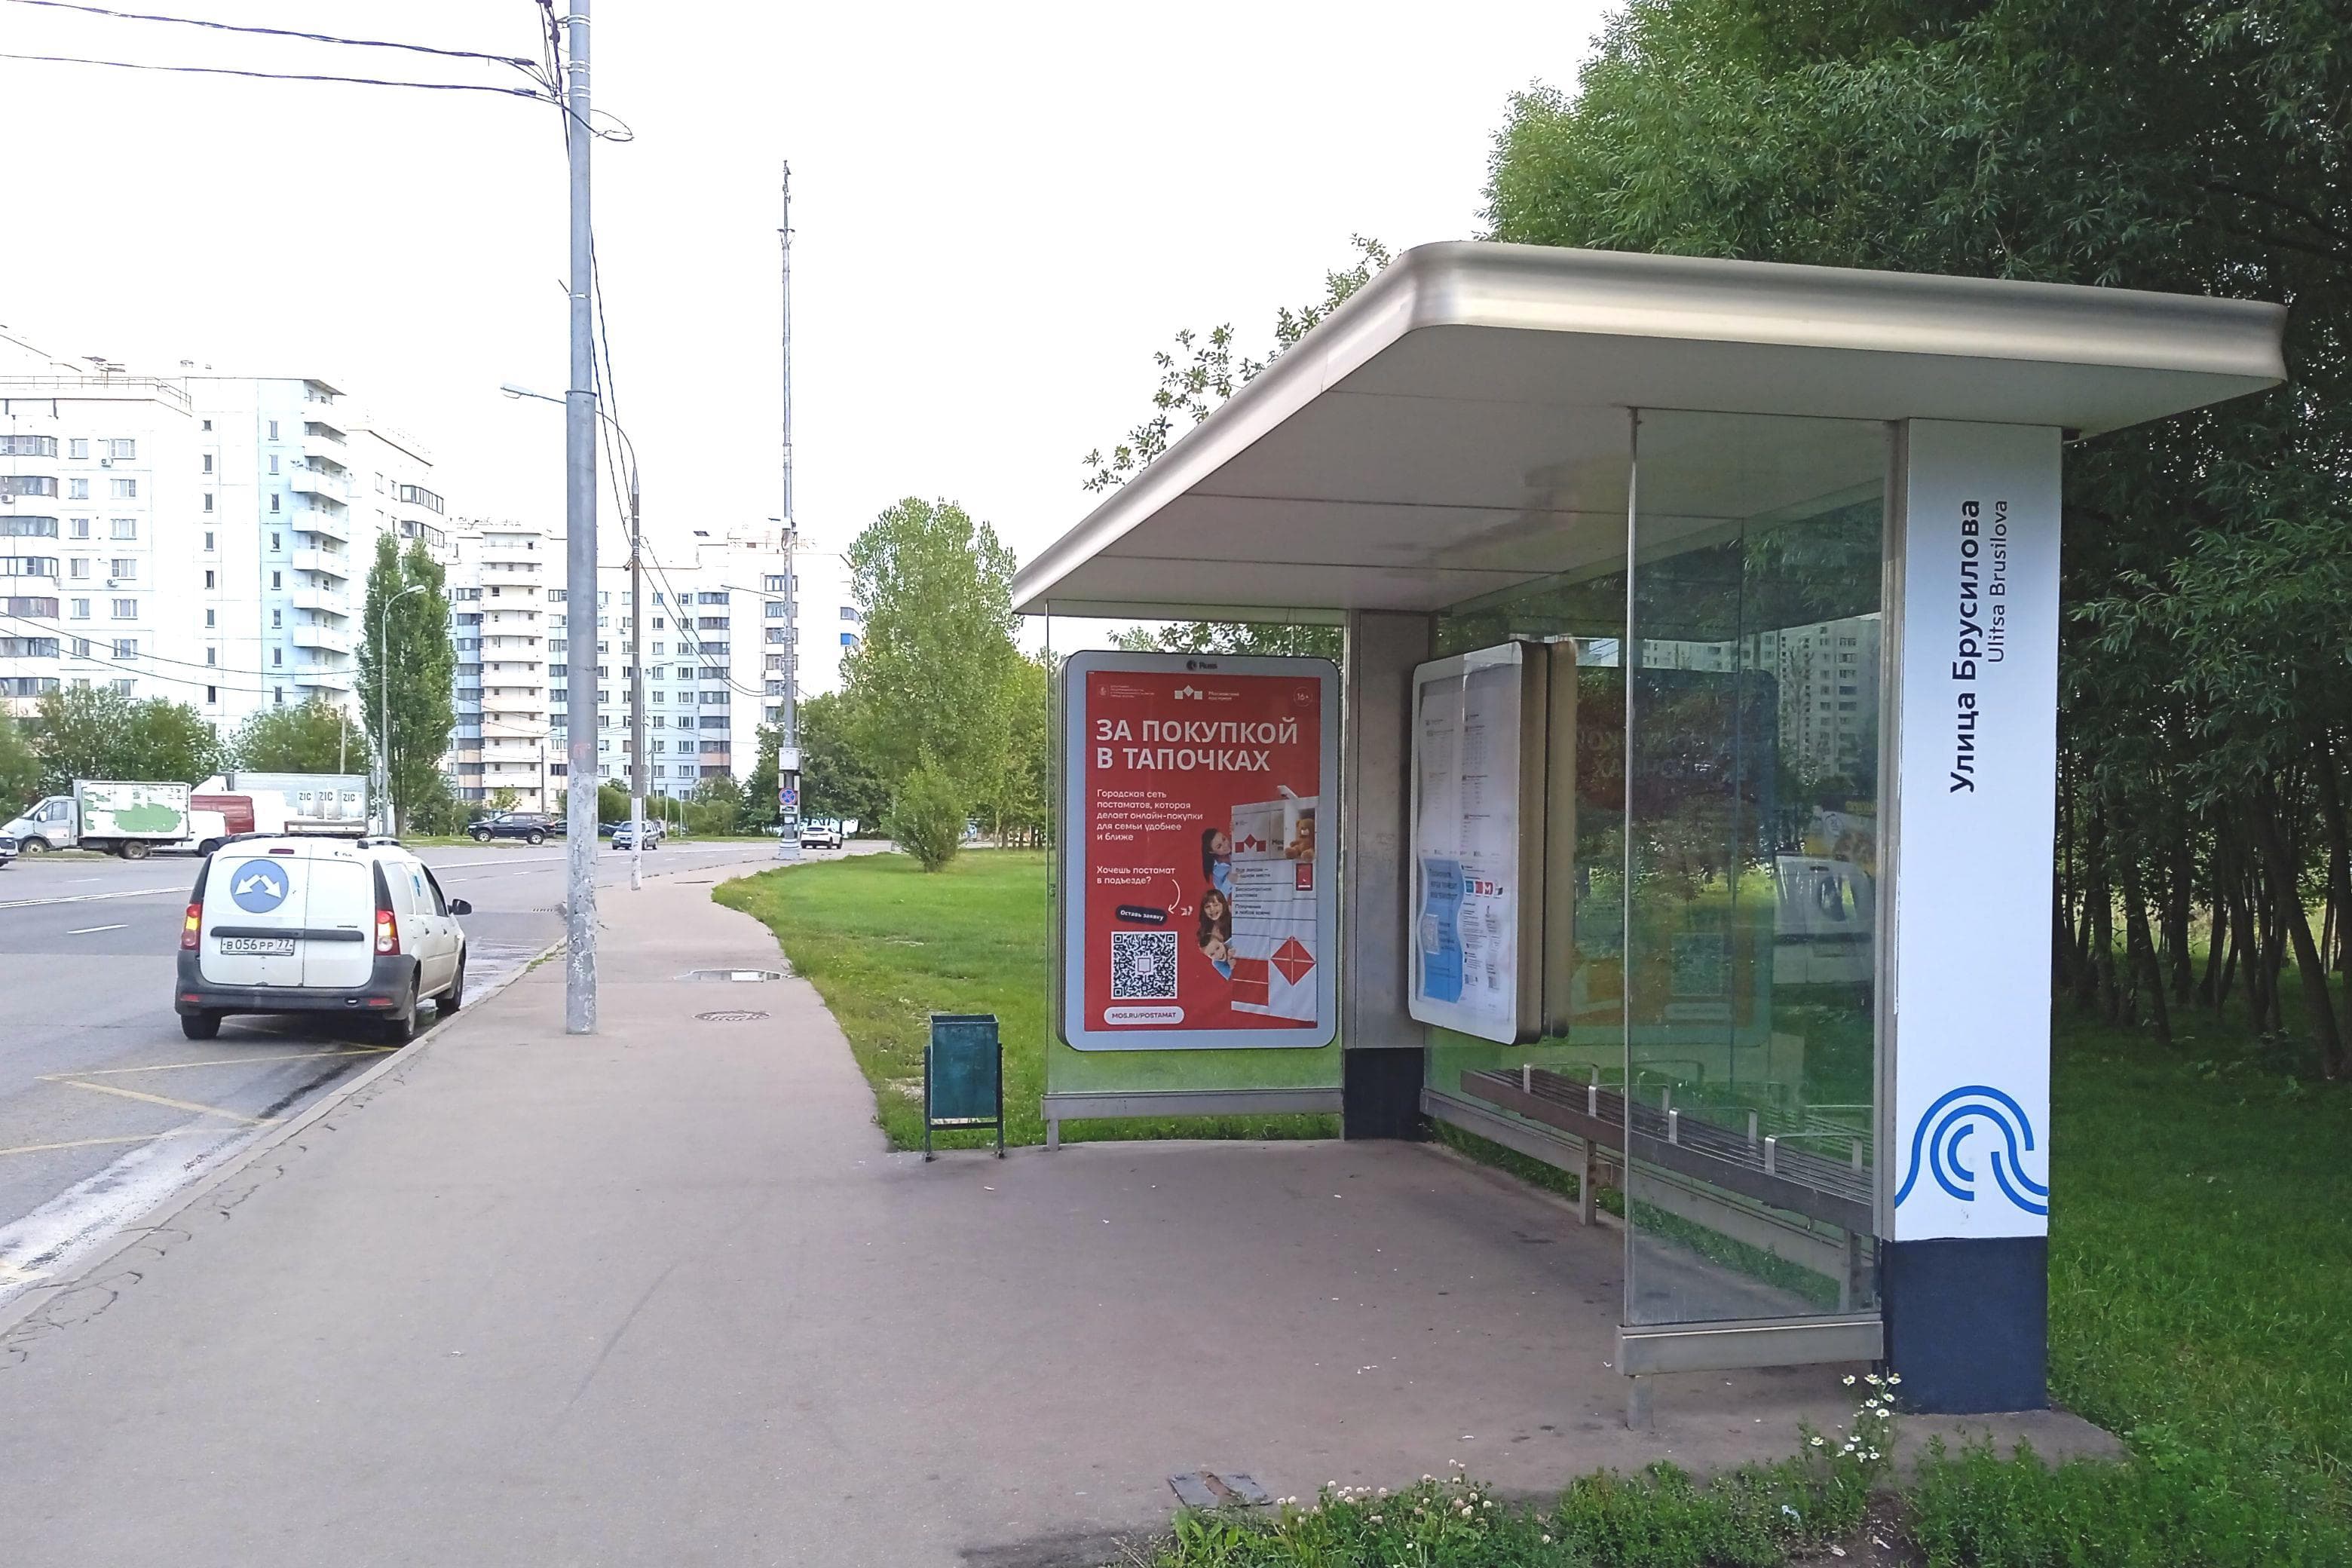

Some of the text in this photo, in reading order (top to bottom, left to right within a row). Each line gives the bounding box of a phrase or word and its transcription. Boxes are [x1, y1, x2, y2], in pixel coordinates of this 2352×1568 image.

[1987, 501, 2007, 662] Ulitsa Brusilova
[1950, 501, 1983, 793] Улица Брусилова
[1096, 717, 1297, 744] ЗА ПОКУПКОЙ
[1097, 747, 1270, 771] В ТАПОЧКАХ
[299, 792, 311, 801] ZIC
[319, 792, 333, 801] ZIC
[1097, 789, 1144, 798] Городская
[1130, 812, 1203, 821] онлайн-покупки
[1144, 822, 1182, 831] удобнее
[1104, 876, 1152, 885] подъезде?
[1143, 912, 1164, 921] заявку
